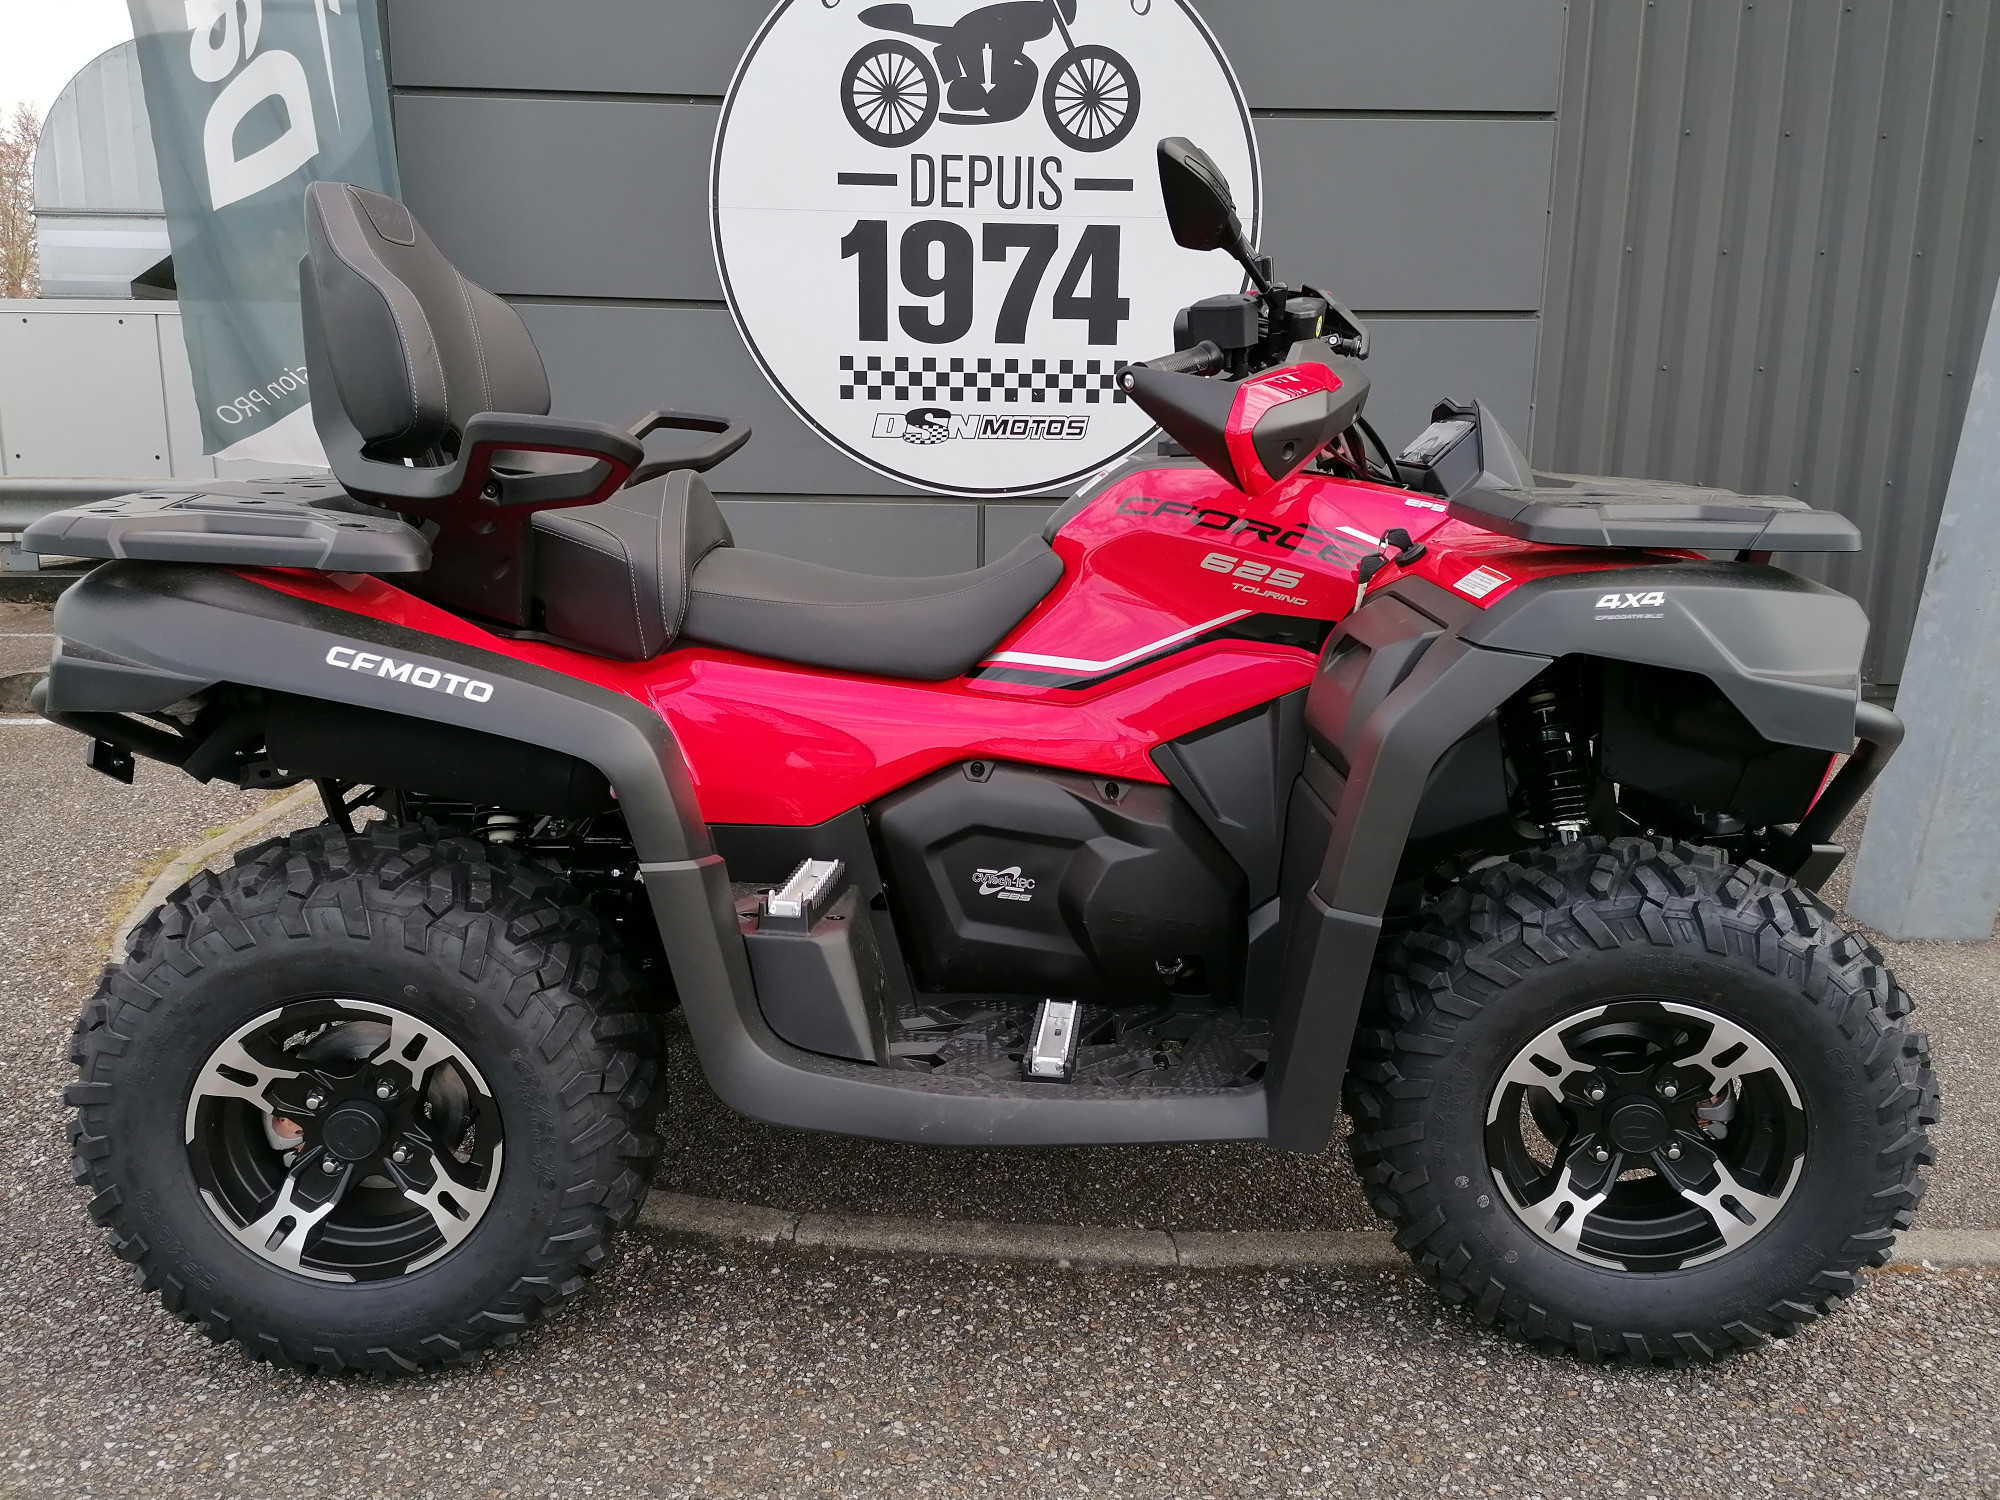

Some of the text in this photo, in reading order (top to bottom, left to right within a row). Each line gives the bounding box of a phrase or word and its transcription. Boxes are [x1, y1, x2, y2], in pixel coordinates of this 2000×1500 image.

[910, 154, 1063, 210] DEPUIS
[840, 219, 1131, 346] 1974
[872, 407, 1090, 445] DSN MOTOS
[1404, 498, 1447, 513] EPS
[1115, 496, 1375, 570] CFORCE
[1200, 552, 1304, 588] 625
[1231, 582, 1308, 606] TOURING
[1595, 591, 1666, 609] 4X4
[325, 646, 494, 703] CFMOTO
[997, 892, 1032, 902] EBS
